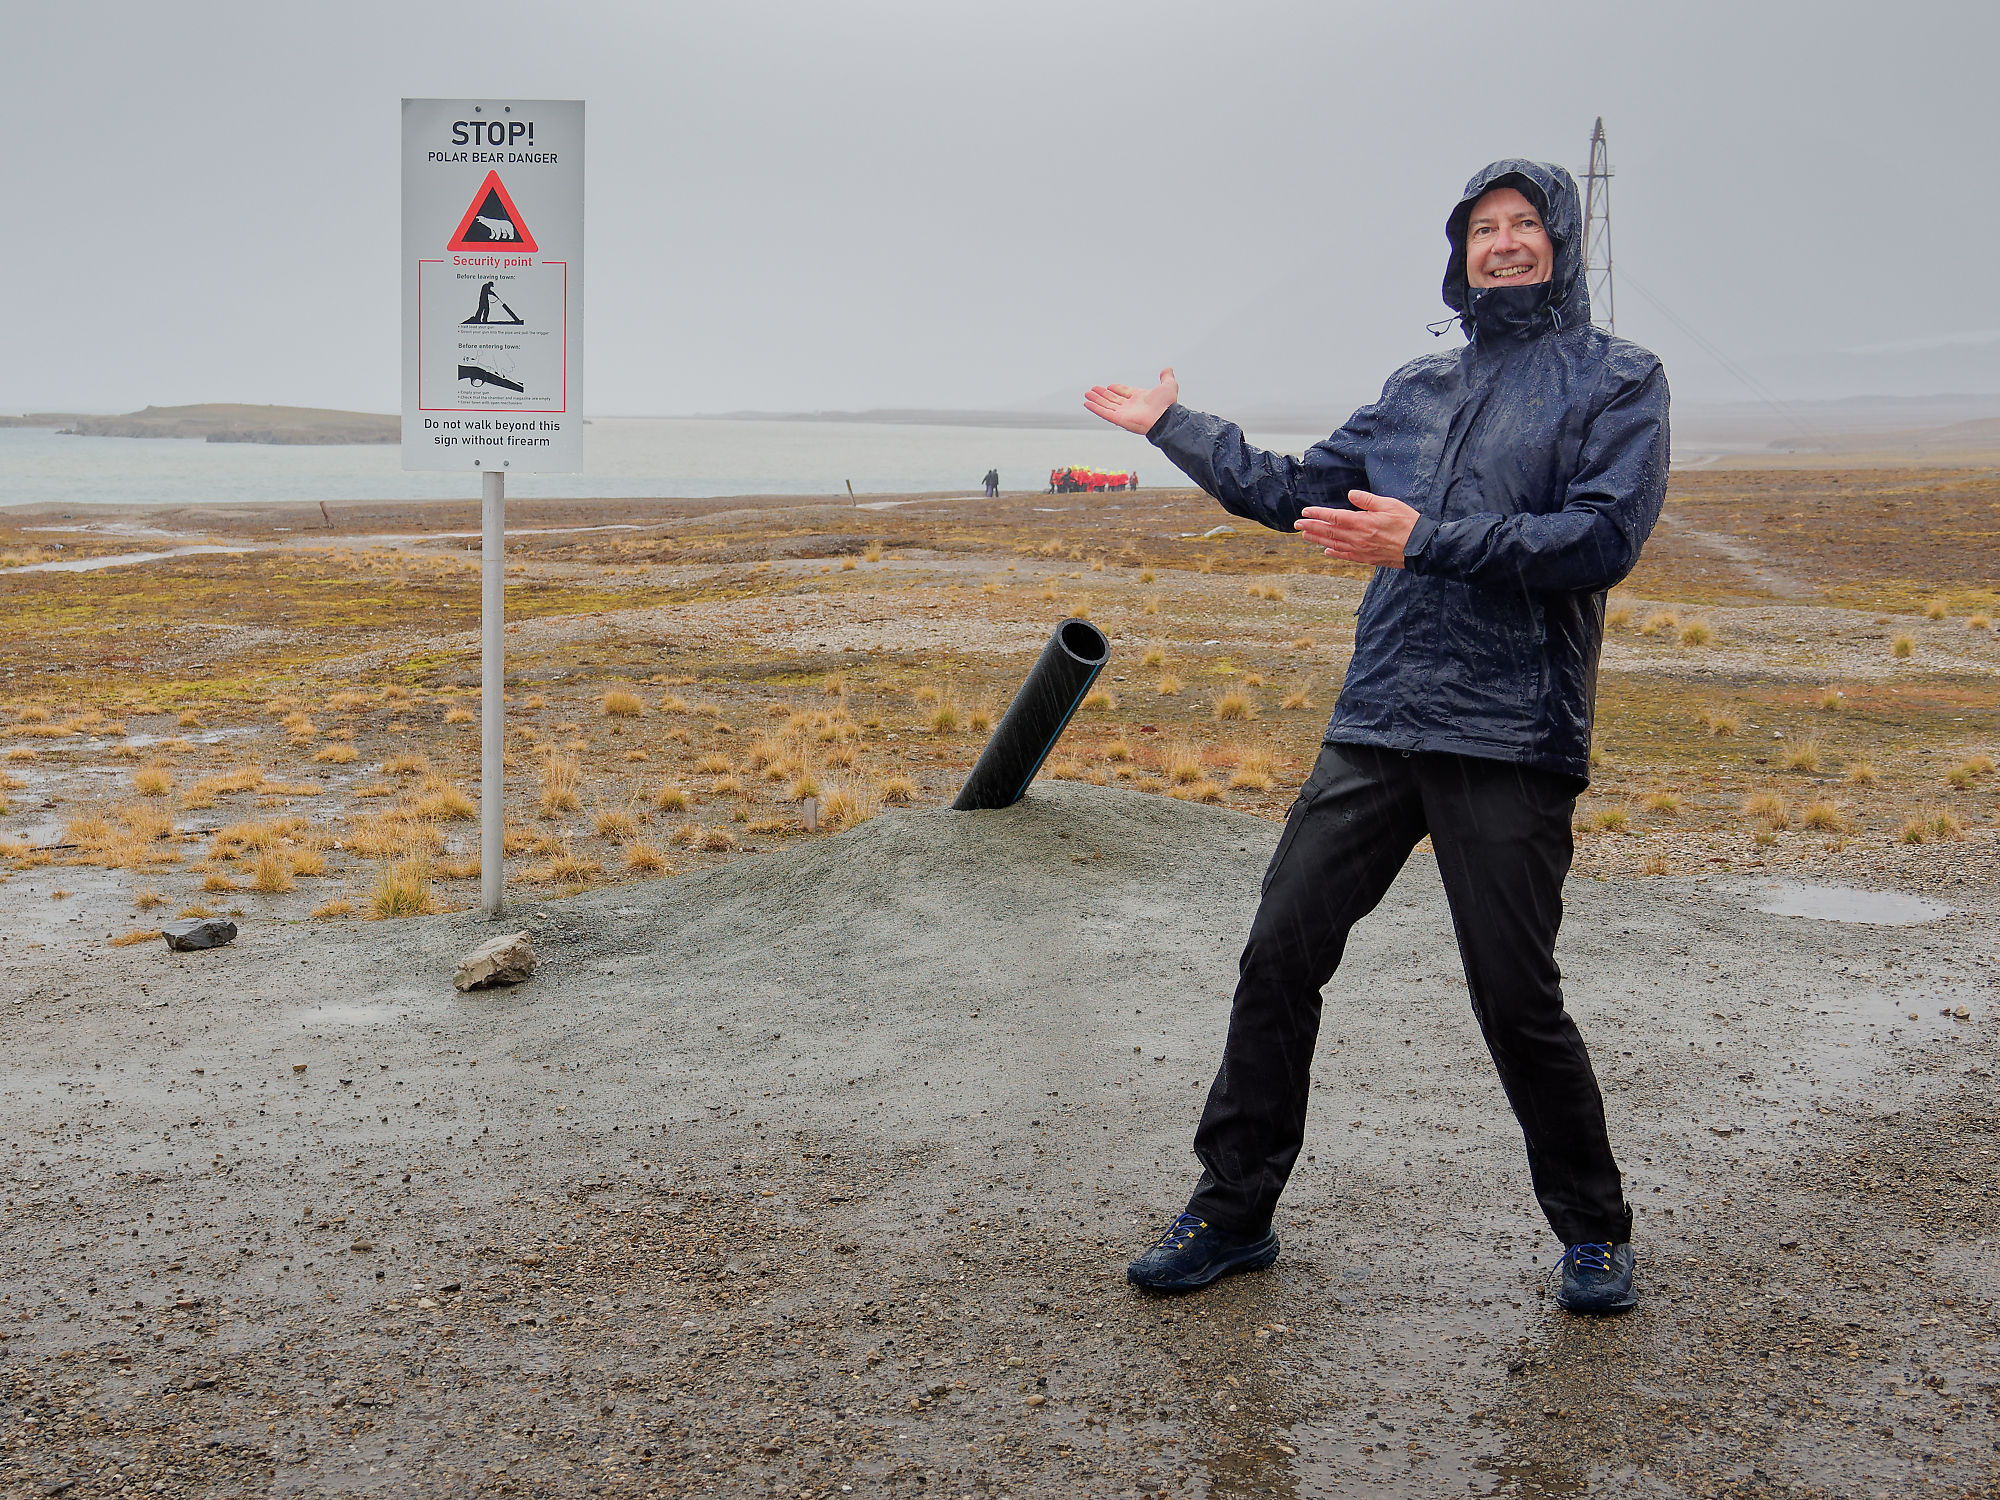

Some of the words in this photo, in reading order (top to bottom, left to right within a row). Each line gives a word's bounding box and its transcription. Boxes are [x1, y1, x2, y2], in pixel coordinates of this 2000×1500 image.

[452, 121, 533, 146] STOP!
[429, 152, 467, 162] POLAR
[472, 153, 504, 162] BEAR
[509, 153, 557, 163] DANGER
[453, 256, 500, 268] Security
[504, 257, 532, 269] point
[425, 419, 439, 428] Do
[444, 420, 460, 429] not
[465, 420, 491, 429] walk
[496, 420, 535, 432] beyond
[540, 421, 560, 430] this
[435, 435, 457, 447] sign
[462, 435, 503, 445] without
[508, 436, 549, 446] firearm
